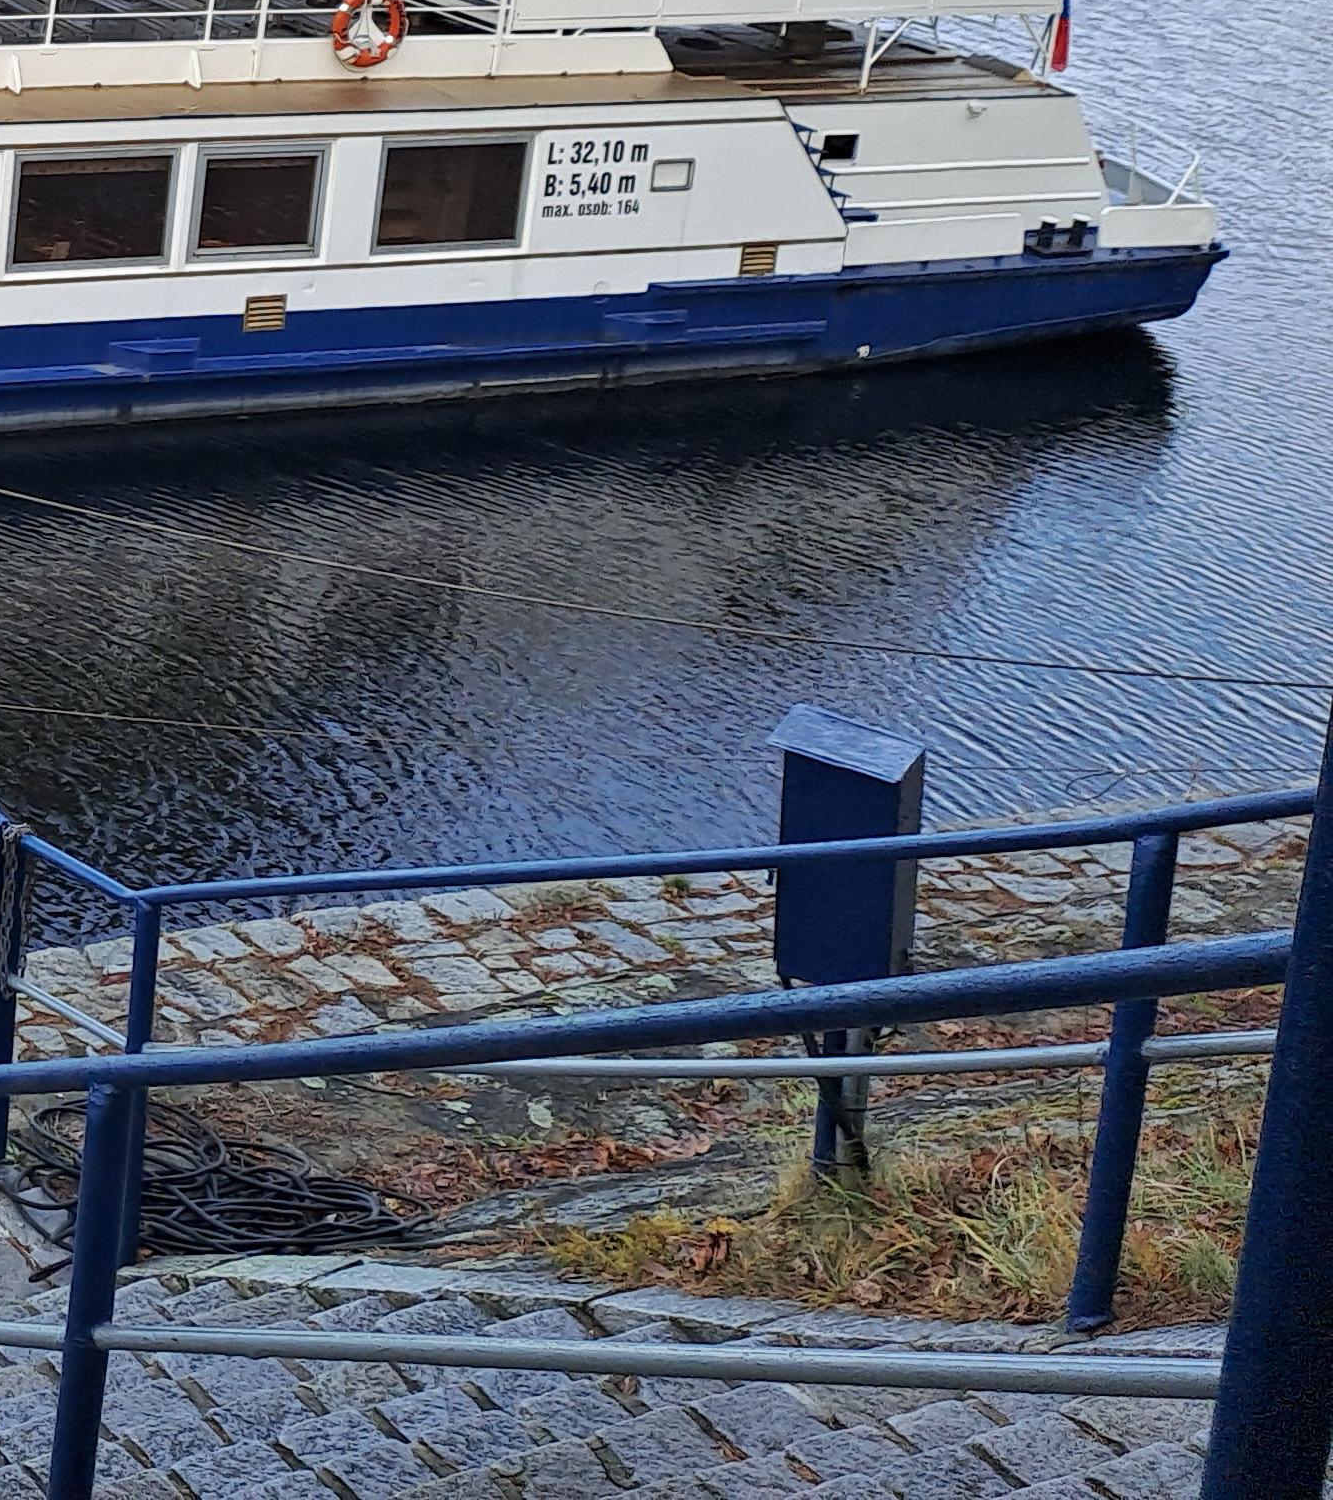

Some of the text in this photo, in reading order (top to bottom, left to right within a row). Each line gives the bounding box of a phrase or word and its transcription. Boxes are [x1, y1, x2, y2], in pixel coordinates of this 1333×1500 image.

[547, 140, 649, 167] L: 32,10 m
[544, 172, 636, 199] B: 5,40 m
[542, 200, 641, 218] max. osob: 164
